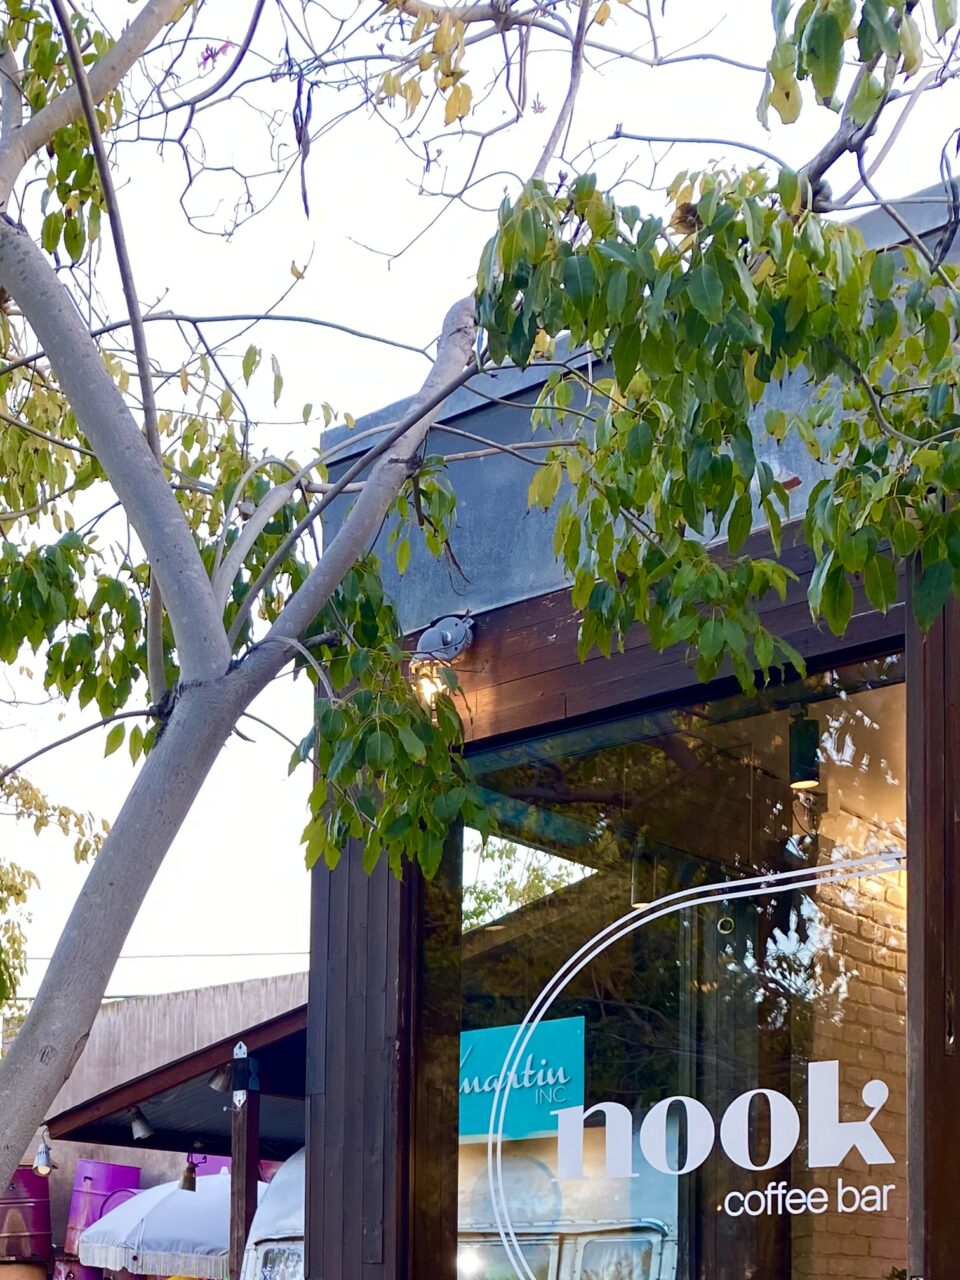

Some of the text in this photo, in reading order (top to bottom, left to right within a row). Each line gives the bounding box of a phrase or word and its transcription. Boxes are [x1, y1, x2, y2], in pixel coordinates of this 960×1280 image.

[535, 1086, 567, 1104] INC
[549, 1060, 896, 1182] nook
[724, 1178, 896, 1217] coffee bar
